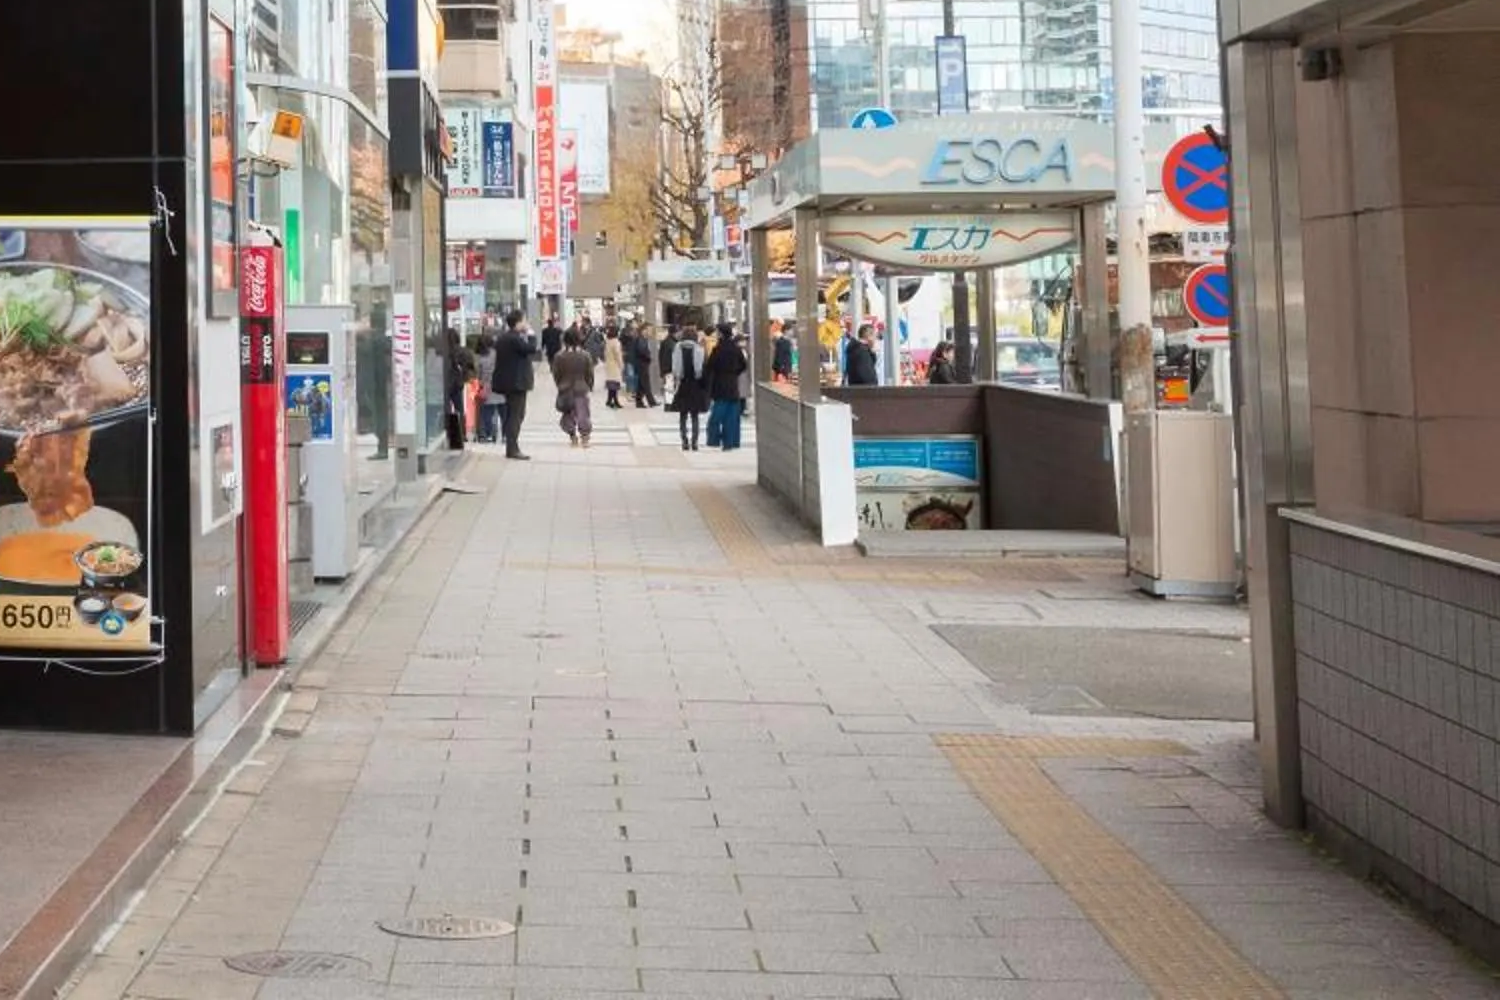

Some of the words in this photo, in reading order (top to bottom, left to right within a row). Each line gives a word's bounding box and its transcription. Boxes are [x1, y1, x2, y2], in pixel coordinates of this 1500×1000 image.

[920, 137, 1074, 185] ESCA
[902, 225, 991, 251] エスカ
